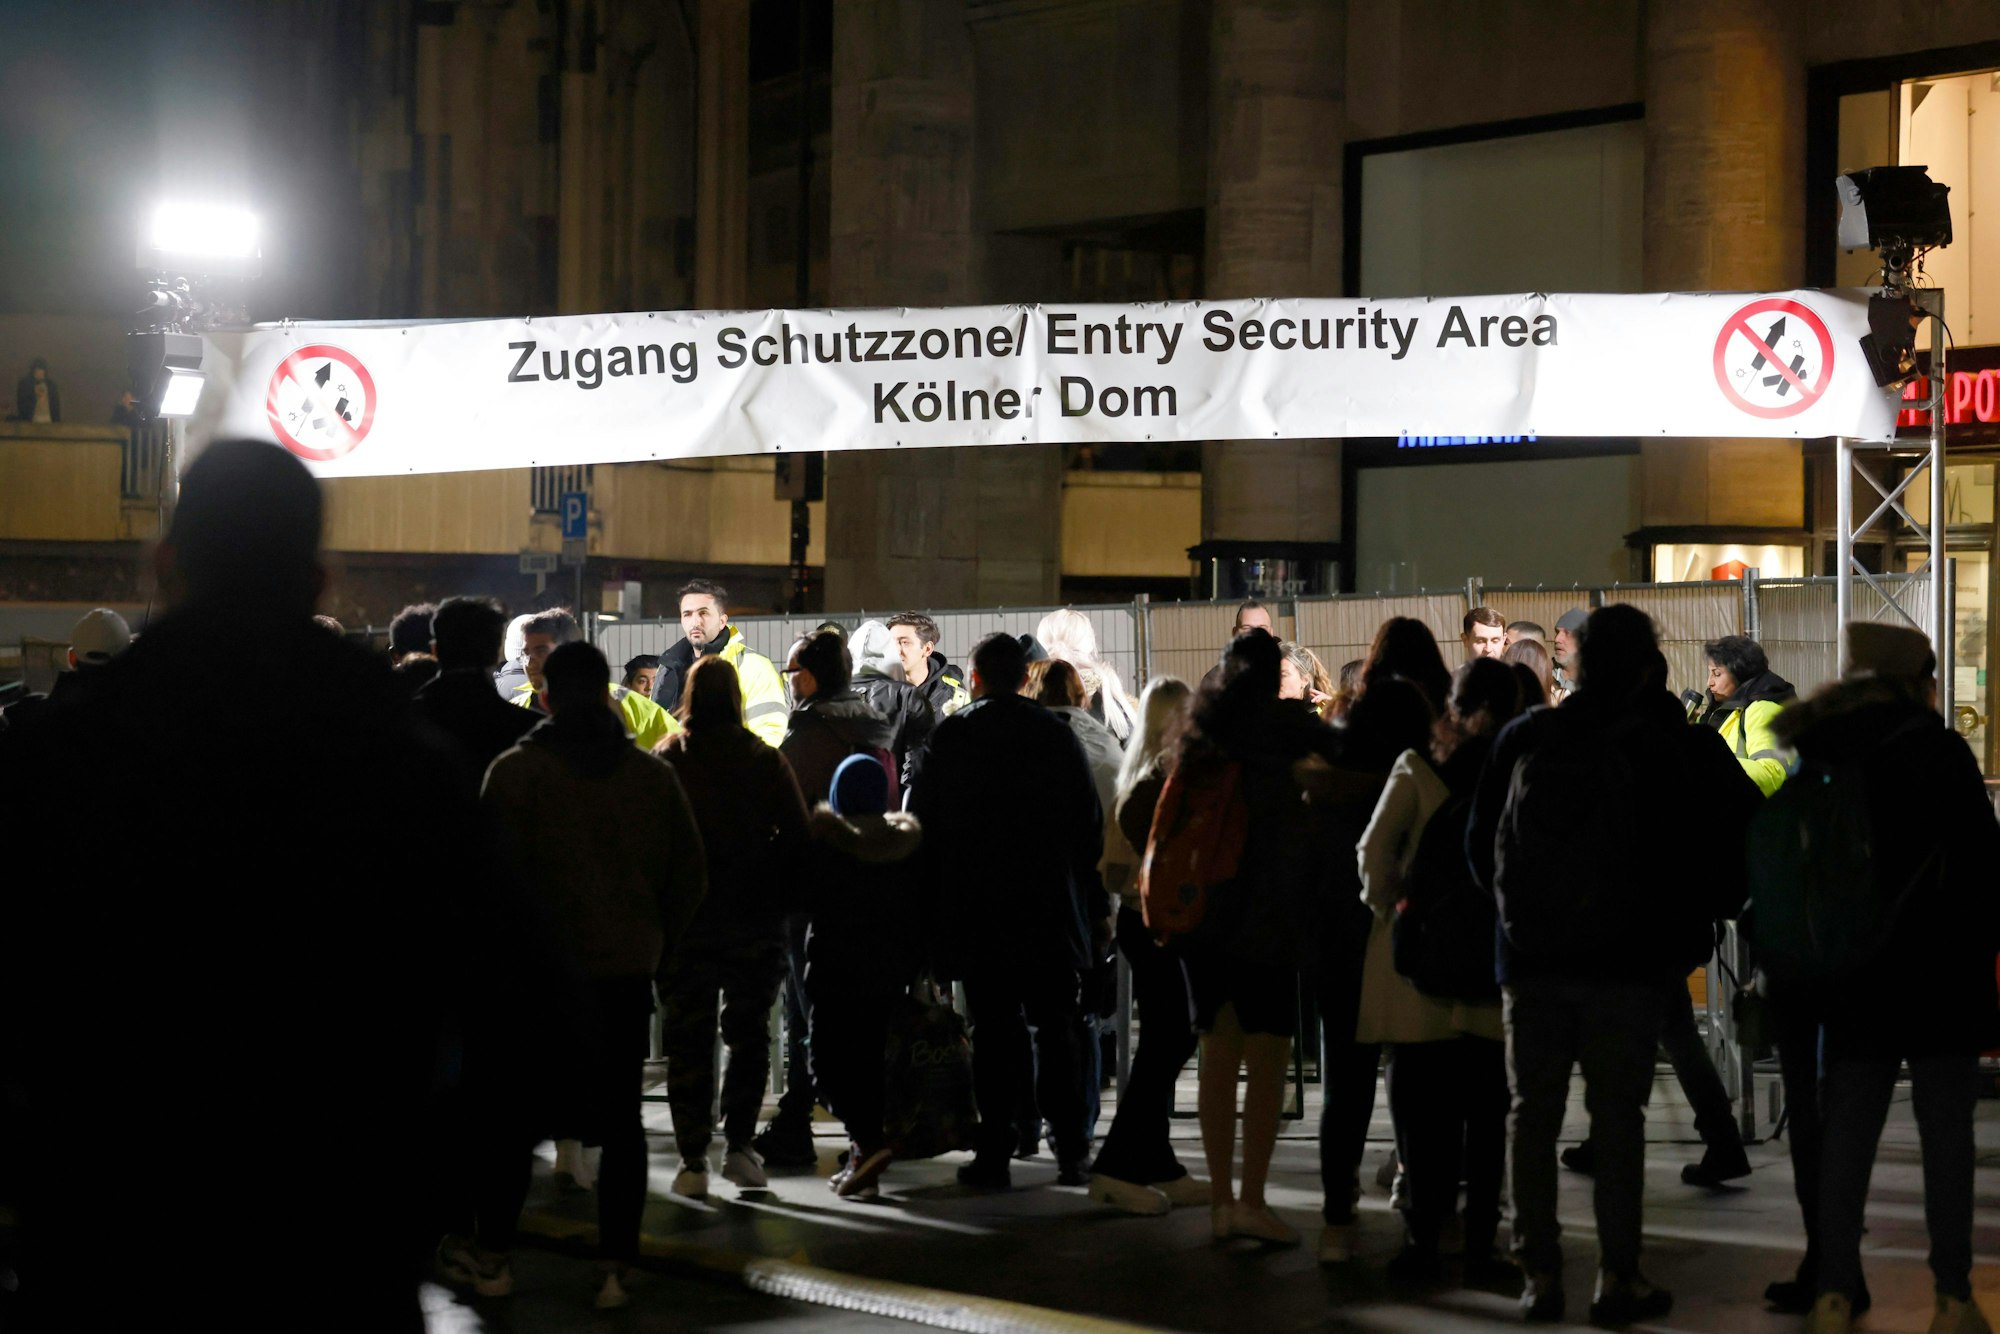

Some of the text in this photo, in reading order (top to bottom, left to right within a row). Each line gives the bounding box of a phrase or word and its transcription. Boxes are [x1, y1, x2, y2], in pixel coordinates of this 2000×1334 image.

[508, 305, 1559, 390] Zugang Schutzzone/ Entry Security Area
[873, 375, 1177, 424] Kölner Dom
[566, 498, 582, 533] P
